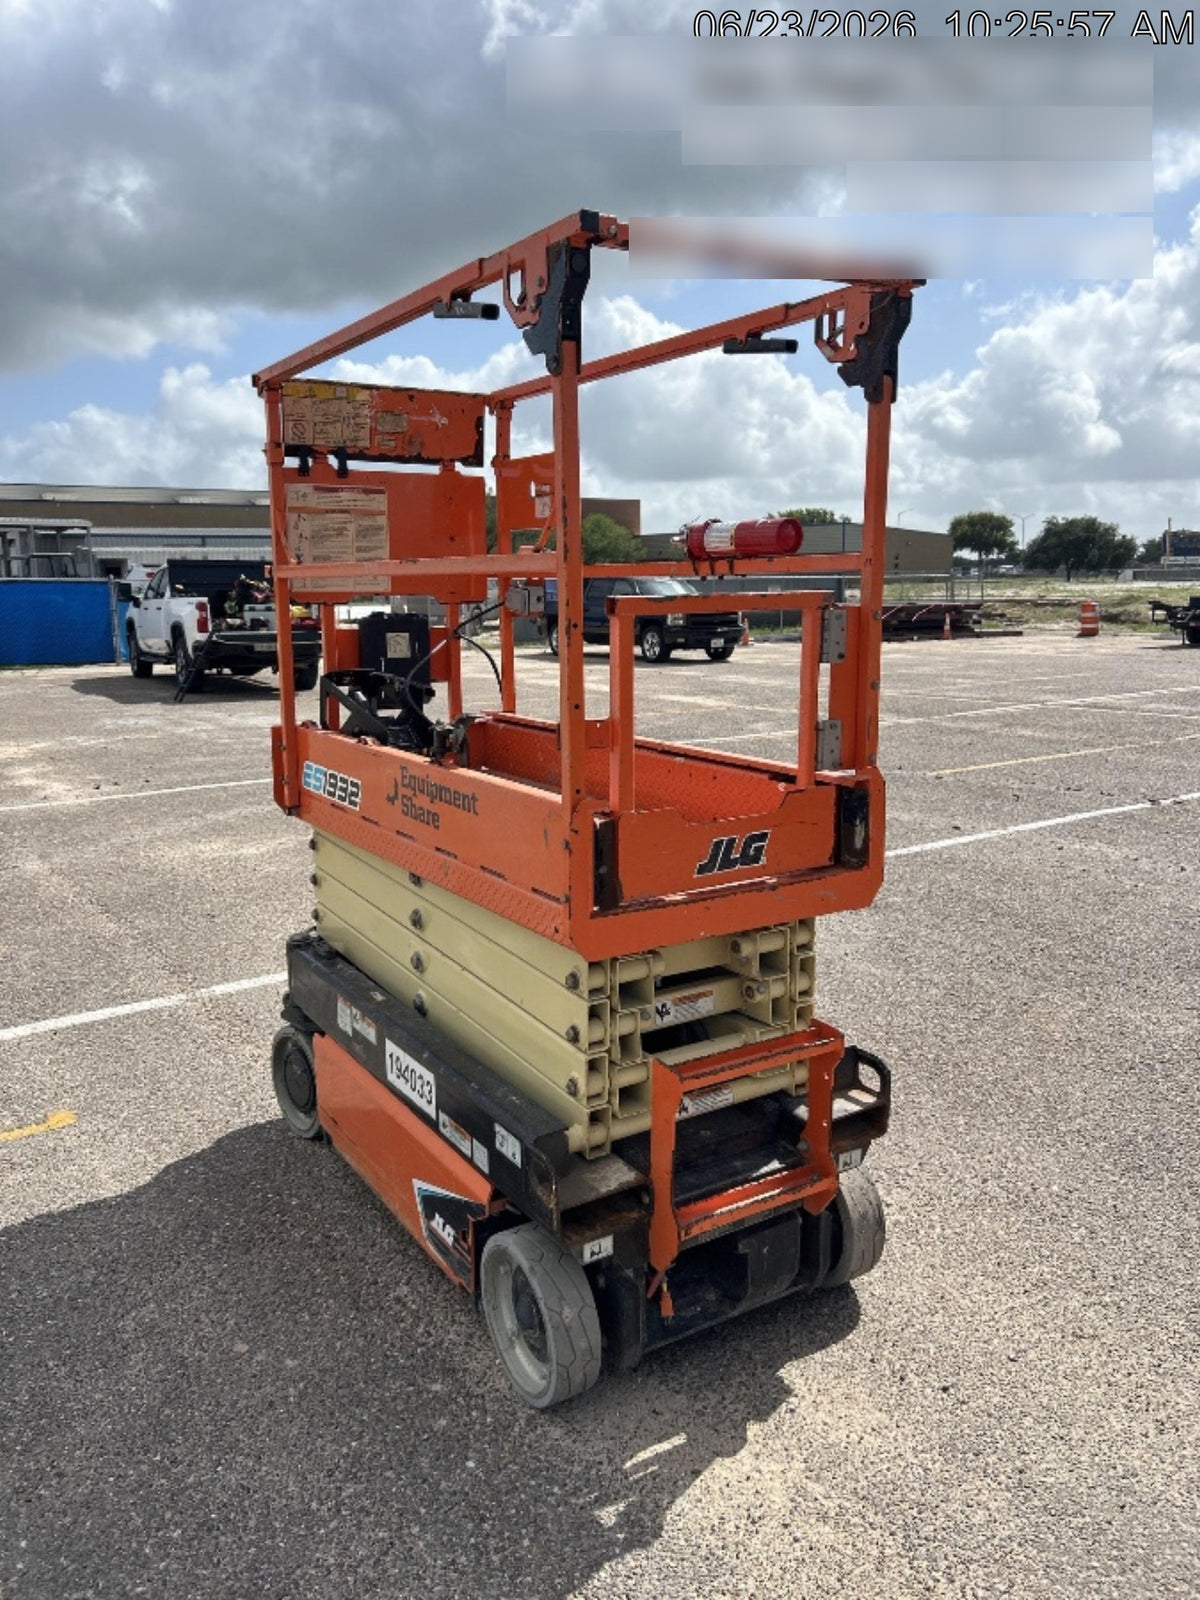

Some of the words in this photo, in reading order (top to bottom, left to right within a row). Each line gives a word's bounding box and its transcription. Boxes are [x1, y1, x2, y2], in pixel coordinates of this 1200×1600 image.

[401, 765, 479, 816] Equipment
[401, 794, 440, 831] Share
[694, 830, 772, 878] JLG
[388, 1051, 433, 1106] 194033
